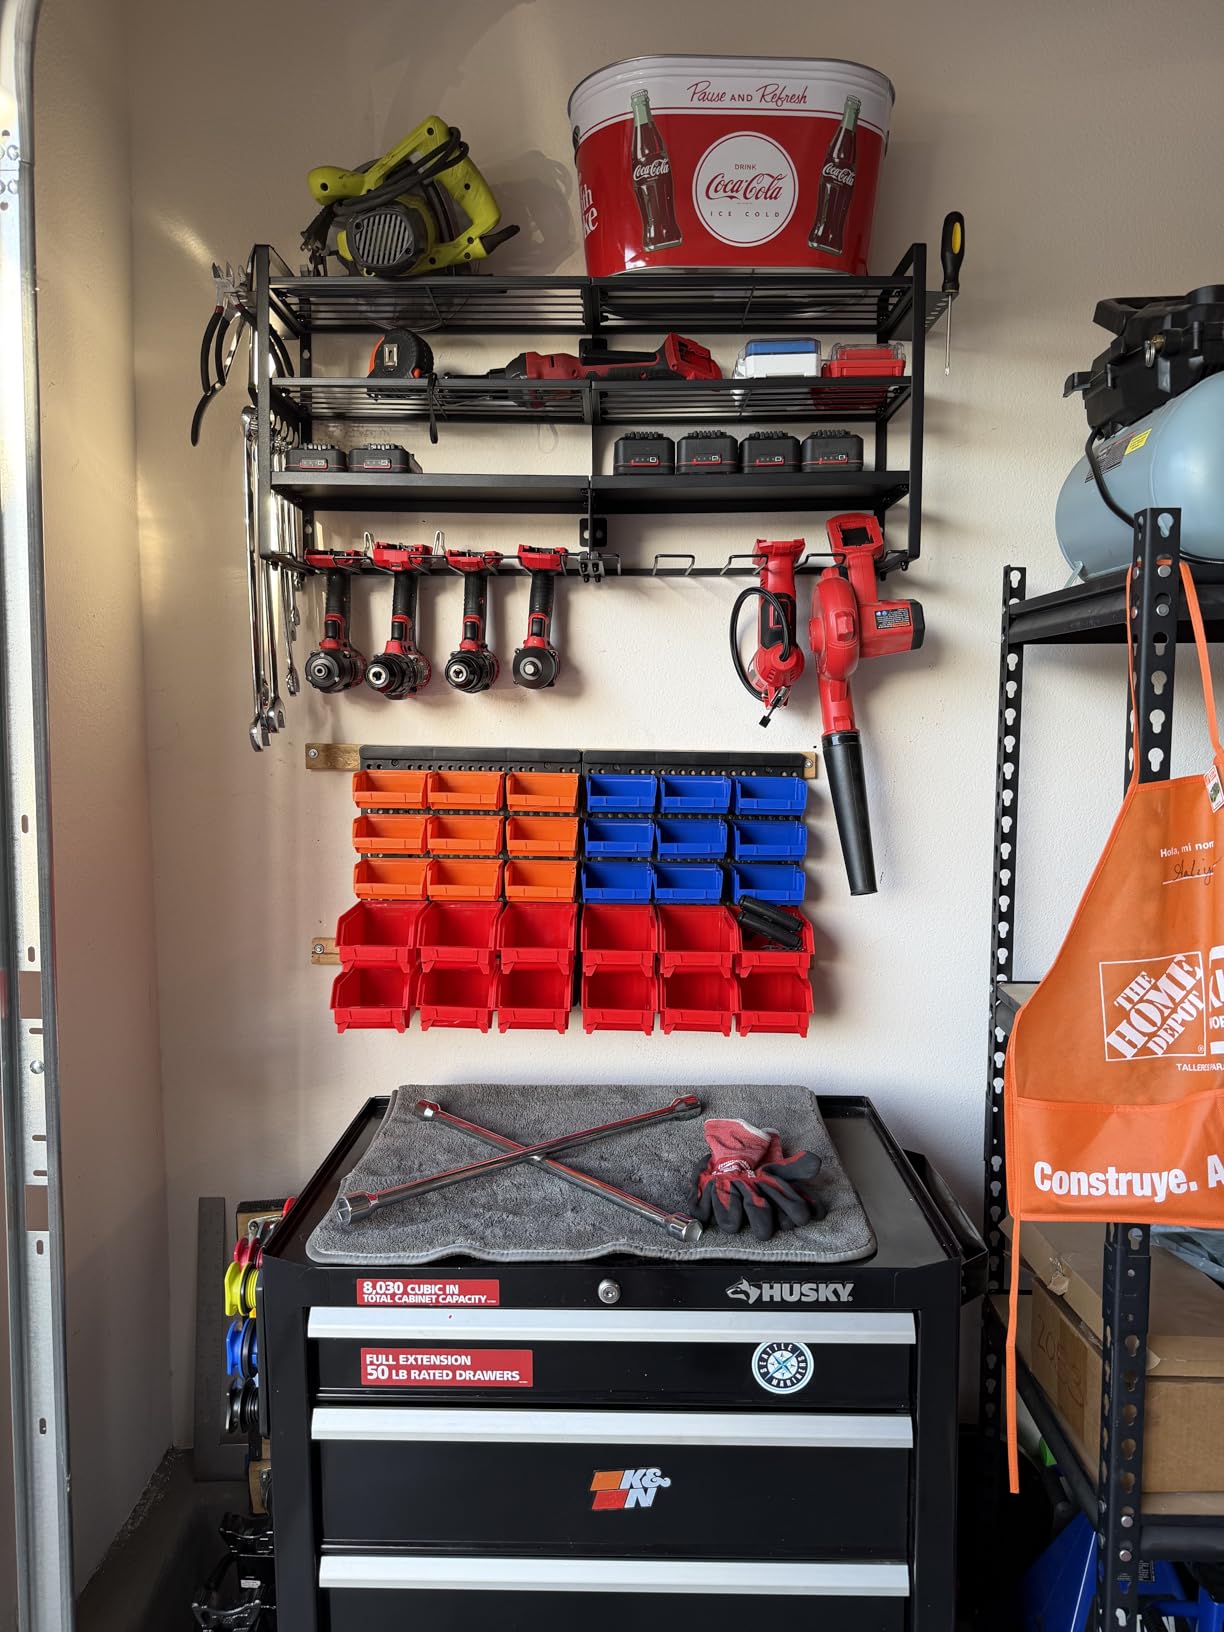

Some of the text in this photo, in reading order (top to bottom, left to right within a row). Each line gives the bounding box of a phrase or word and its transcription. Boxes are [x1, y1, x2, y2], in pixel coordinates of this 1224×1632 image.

[686, 80, 809, 108] Pause AND Refresh
[632, 157, 670, 181] Coca-Cola
[733, 163, 758, 171] DRINK
[822, 162, 856, 187] Coca-Cola
[705, 172, 788, 201] Coca-Cola
[710, 210, 781, 219] ICE COLD
[1181, 843, 1192, 853] mi
[1113, 970, 1156, 1012] THE
[1105, 954, 1203, 1059] HOME
[1145, 990, 1205, 1056] DEPOT
[1033, 1161, 1198, 1203] Construye.
[362, 1281, 459, 1295] 8,030 CUBIC IN
[362, 1294, 393, 1303] TOTAL
[394, 1295, 437, 1304] CABINET
[439, 1295, 487, 1304] CAPACITY
[761, 1282, 854, 1302] HUSKY
[366, 1354, 471, 1366] FULL EXTENSION
[760, 1343, 794, 1374] SEATTLE
[367, 1365, 520, 1381] 50 LB RATED DRAWERS
[771, 1355, 807, 1388] MARINERS
